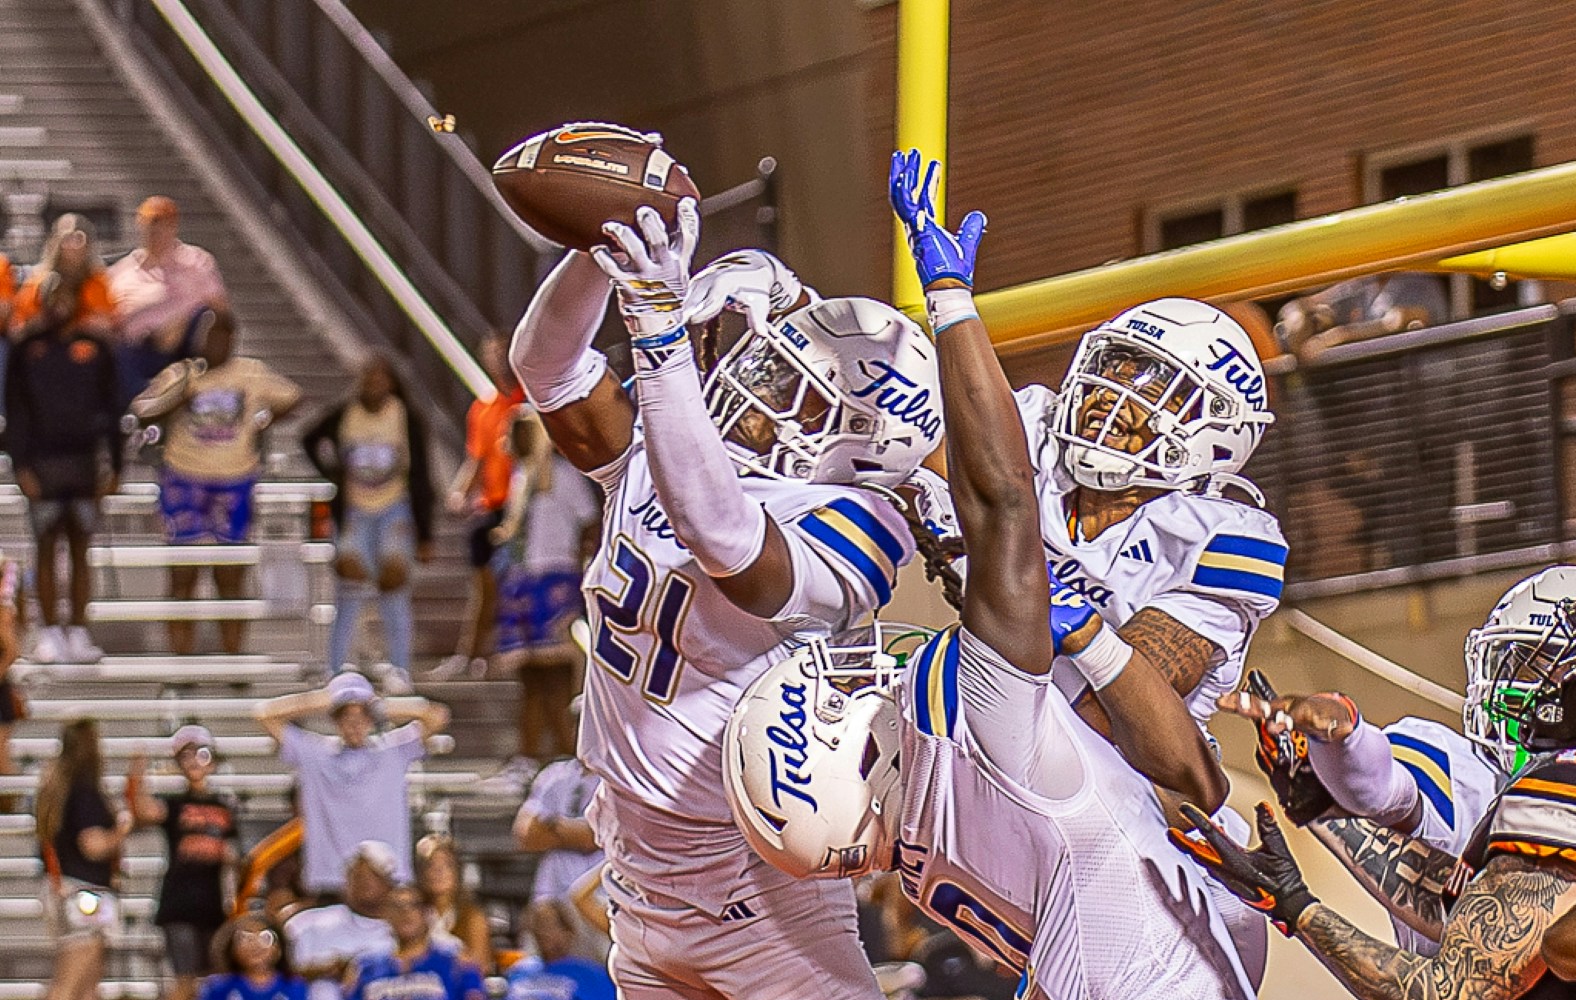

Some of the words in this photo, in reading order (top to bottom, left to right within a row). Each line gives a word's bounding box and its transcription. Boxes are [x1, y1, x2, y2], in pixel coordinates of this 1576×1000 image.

[1126, 319, 1165, 340] TULSA
[851, 360, 941, 441] Tulsa
[1205, 337, 1266, 433] Tuls
[591, 531, 696, 706] 21
[1529, 613, 1554, 627] TUL
[766, 682, 819, 814] Tulsa
